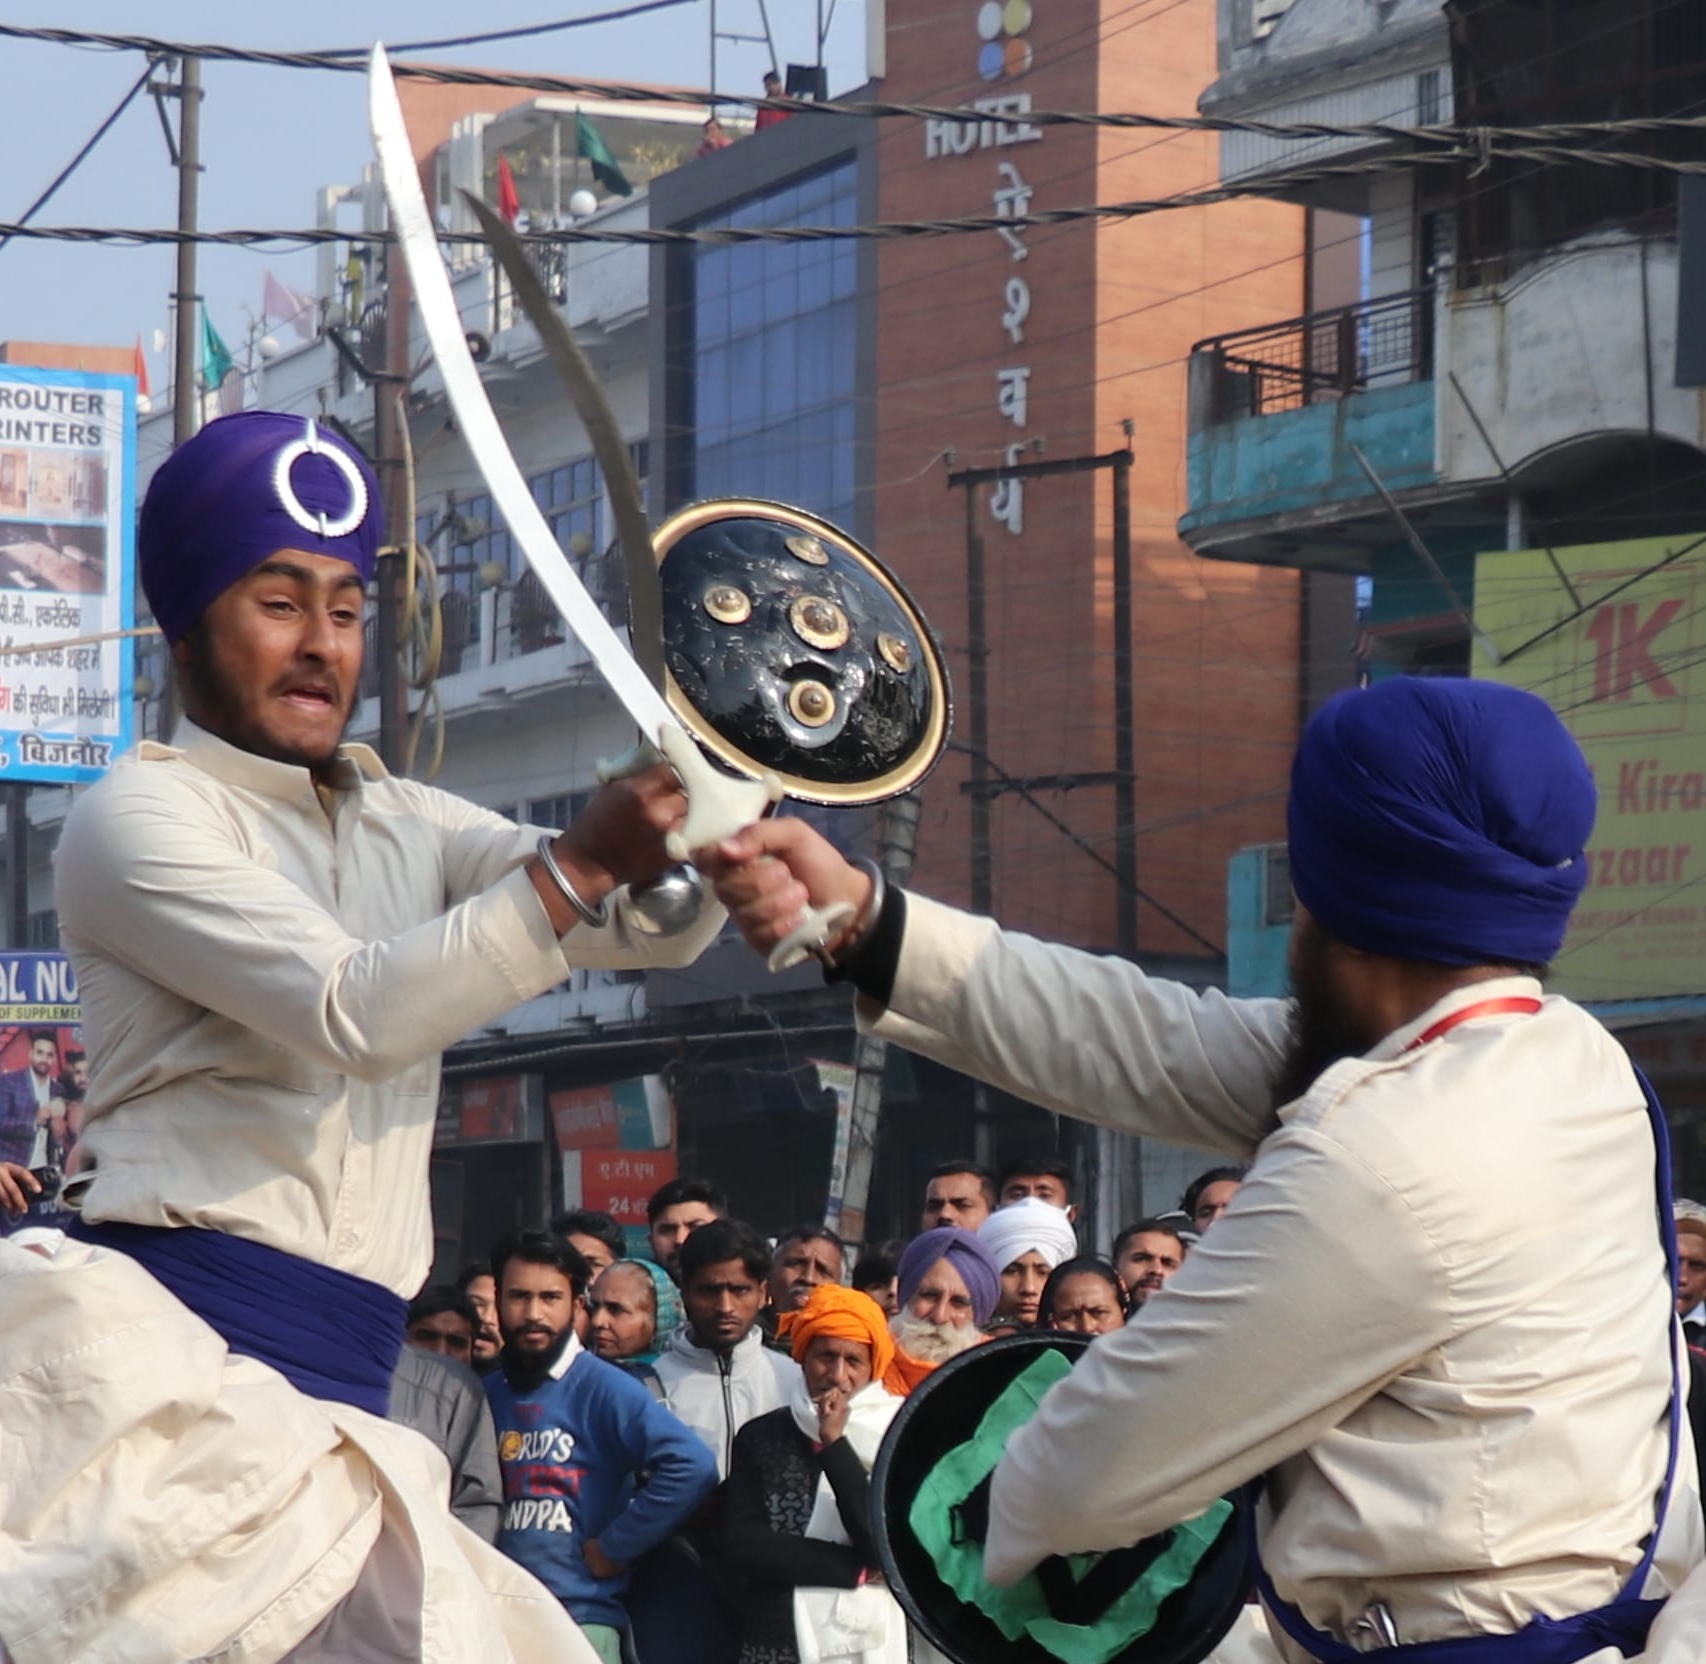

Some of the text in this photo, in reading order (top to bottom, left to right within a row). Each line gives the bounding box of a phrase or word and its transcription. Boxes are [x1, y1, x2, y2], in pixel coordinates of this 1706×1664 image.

[925, 93, 1044, 160] HOTEL
[1583, 597, 1689, 705] 1K
[17, 733, 111, 769] बिजनौर
[1585, 843, 1692, 889] zaar
[35, 960, 80, 1002] NU
[608, 1196, 631, 1216] 24
[498, 1427, 576, 1464] ORLD'S
